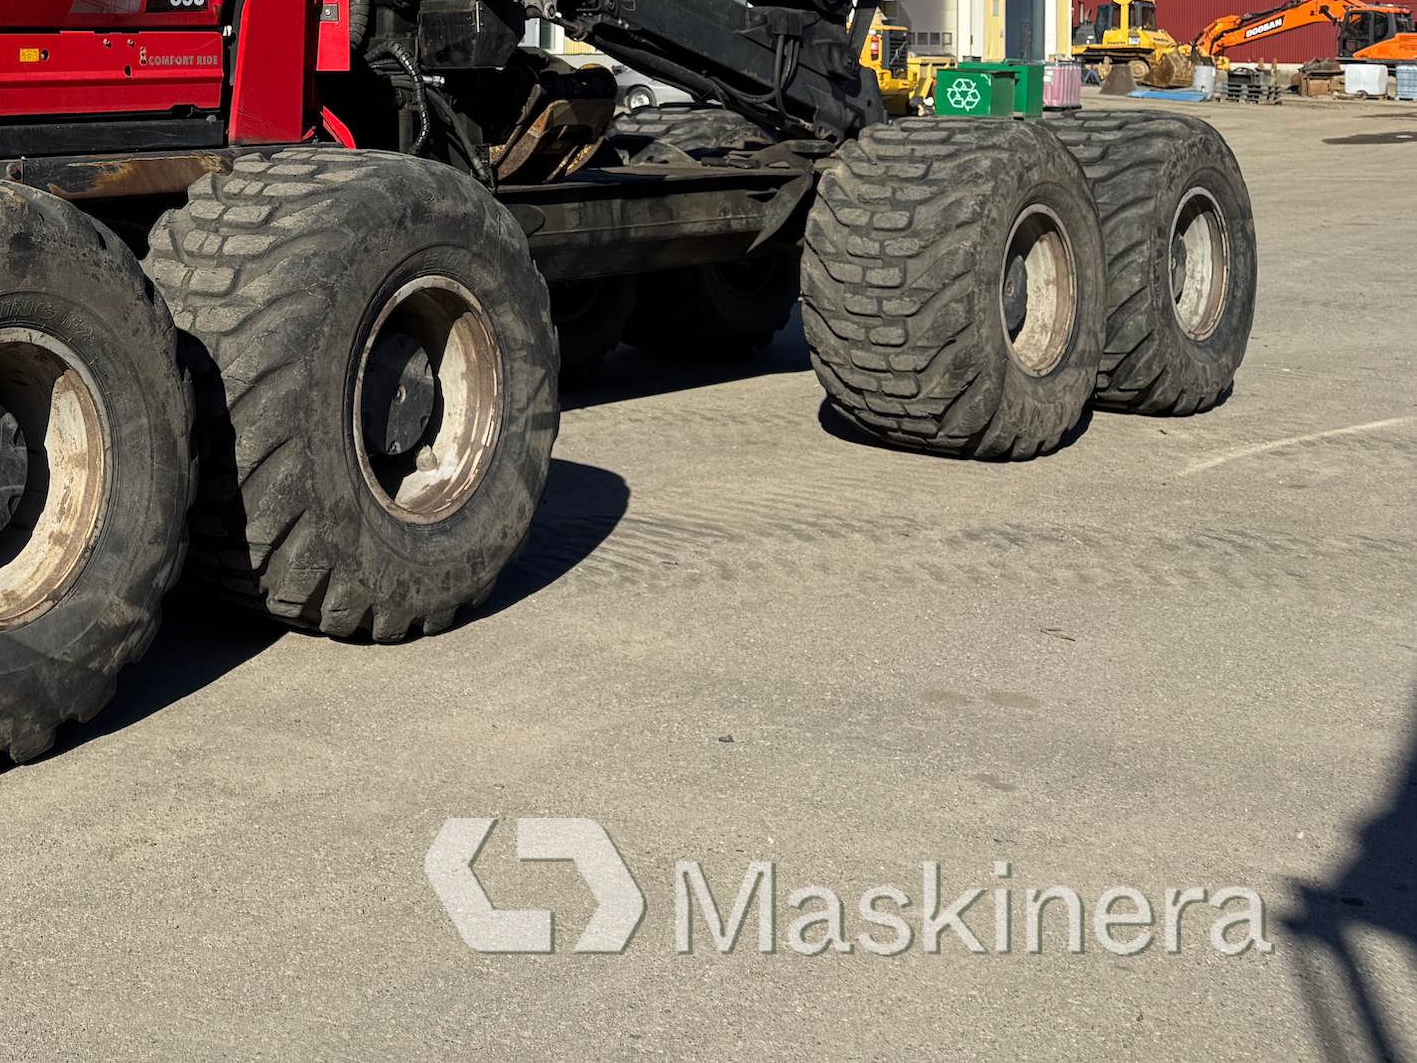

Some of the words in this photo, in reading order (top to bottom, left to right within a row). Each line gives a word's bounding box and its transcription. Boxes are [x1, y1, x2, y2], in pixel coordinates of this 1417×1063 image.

[1246, 18, 1282, 38] DOOSAN
[149, 55, 194, 66] COMFORT
[197, 55, 218, 65] RIDE
